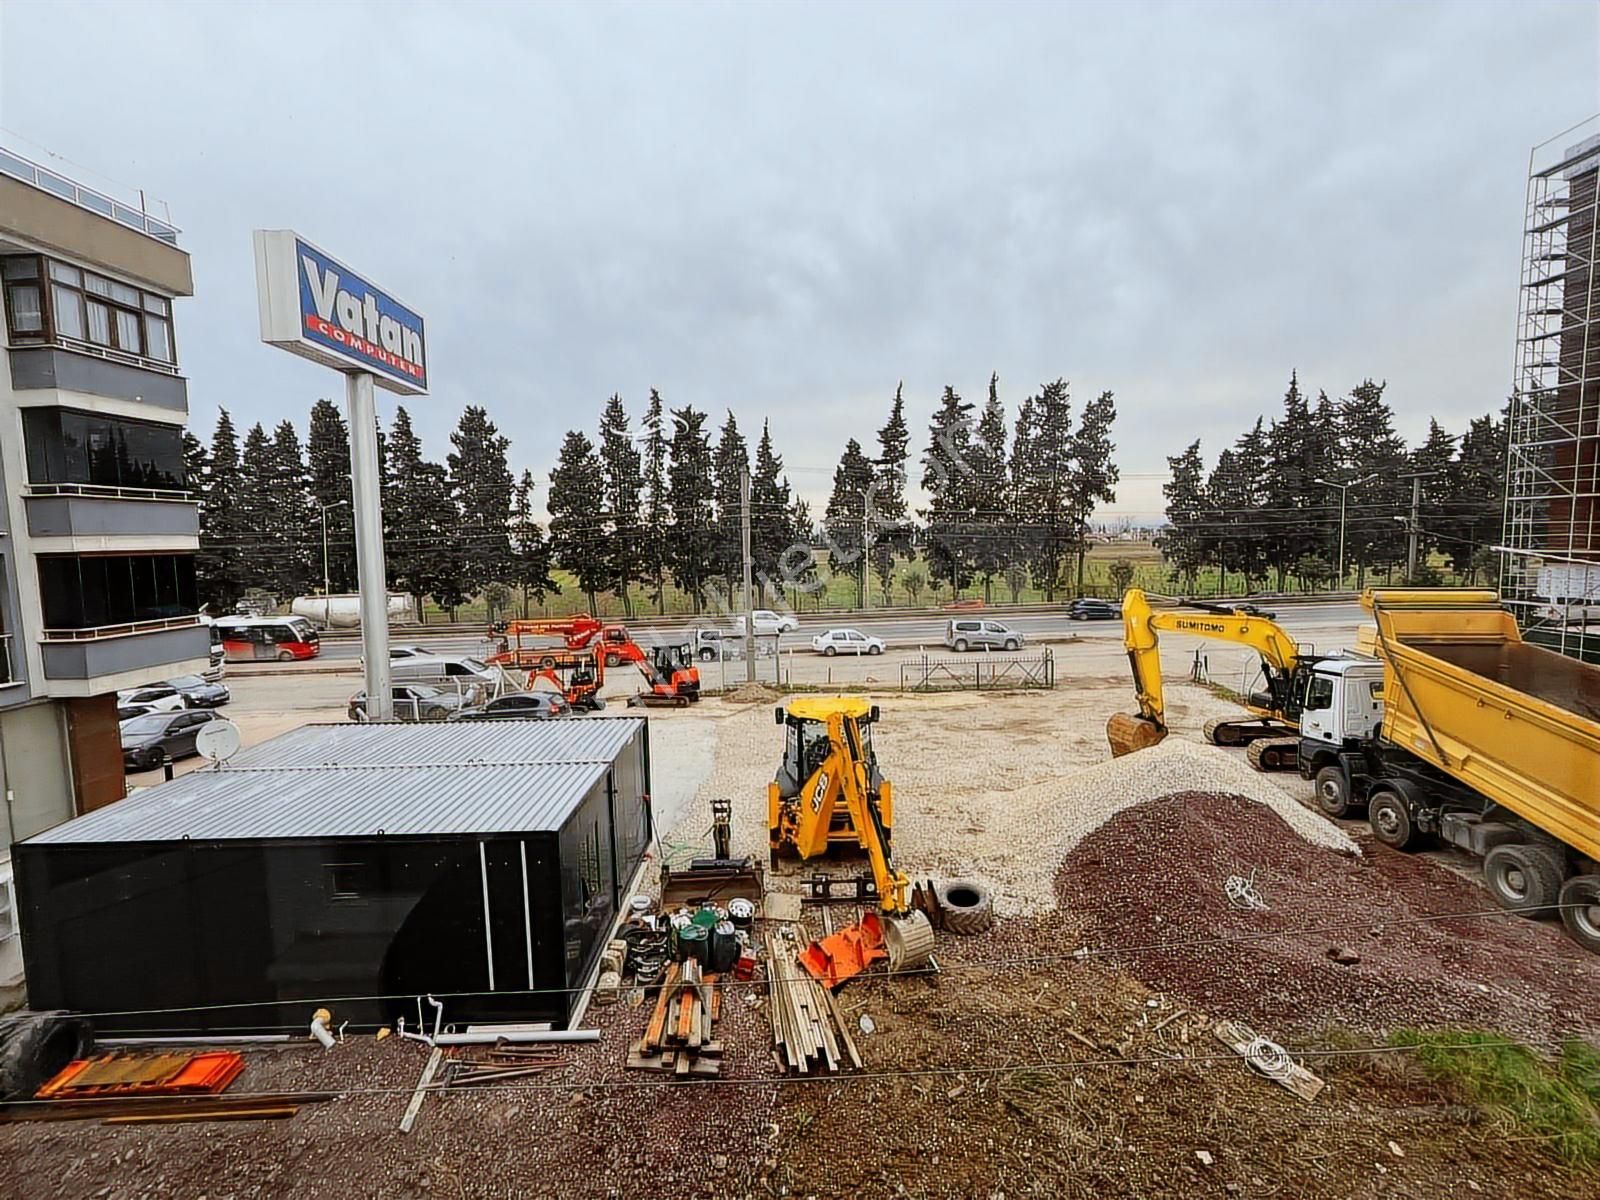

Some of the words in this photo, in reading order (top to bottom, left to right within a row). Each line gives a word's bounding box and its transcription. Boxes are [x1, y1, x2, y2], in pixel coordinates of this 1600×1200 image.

[302, 255, 423, 367] Vatan
[318, 322, 417, 377] COMPUTER
[1176, 619, 1225, 633] SUMITOMO
[811, 773, 829, 813] JCB
